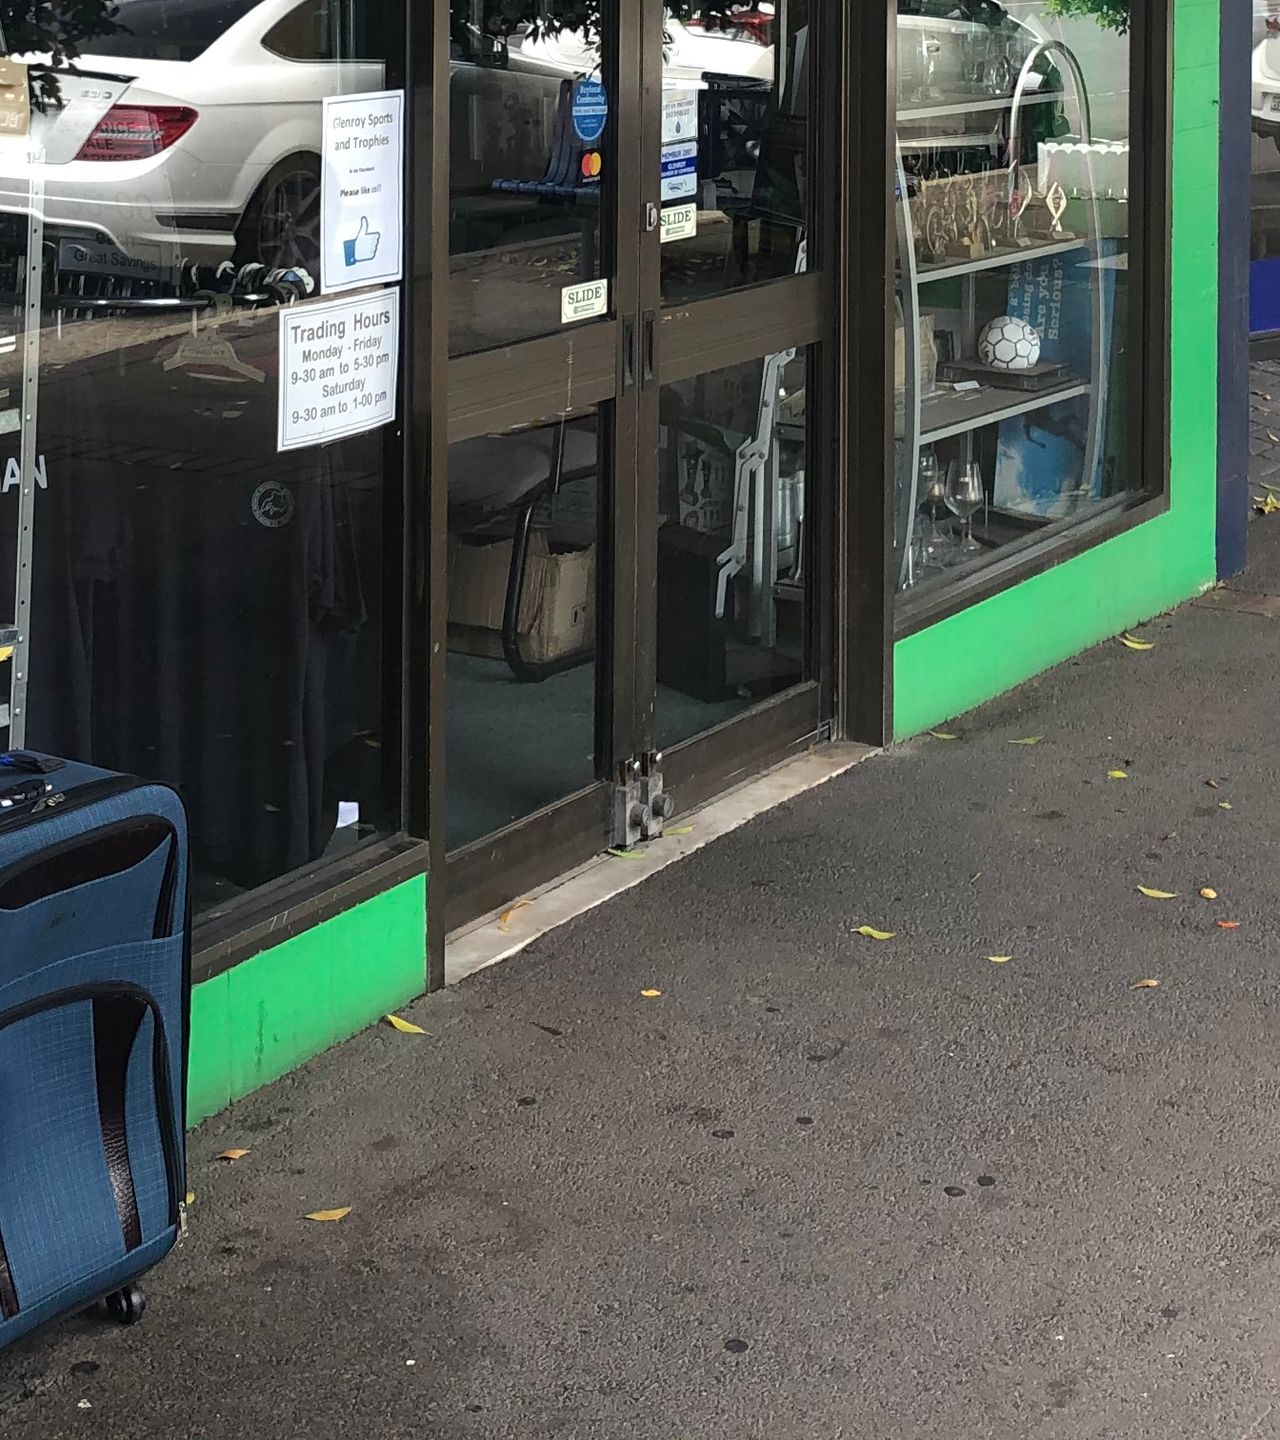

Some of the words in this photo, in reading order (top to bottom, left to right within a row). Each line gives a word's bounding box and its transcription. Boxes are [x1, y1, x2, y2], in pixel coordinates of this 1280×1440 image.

[332, 116, 366, 129] Glenroy
[368, 113, 393, 128] Sports
[335, 137, 351, 151] and
[353, 134, 390, 150] Trophies
[340, 188, 359, 198] Please
[660, 210, 692, 227] SLIDE
[567, 286, 603, 305] SLIDE
[290, 319, 346, 345] Trading
[353, 310, 391, 332] Hours
[302, 345, 344, 364] Monday
[353, 335, 382, 352] Friday
[290, 368, 317, 385] 9-30
[319, 365, 335, 380] am
[339, 362, 349, 375] to
[353, 354, 375, 371] 5-30
[376, 352, 389, 368] pm
[322, 377, 367, 399] Saturday
[291, 407, 317, 425] 9-30
[320, 404, 336, 418] am
[338, 401, 348, 414] to
[352, 392, 373, 410] 1-00
[374, 390, 387, 406] pm
